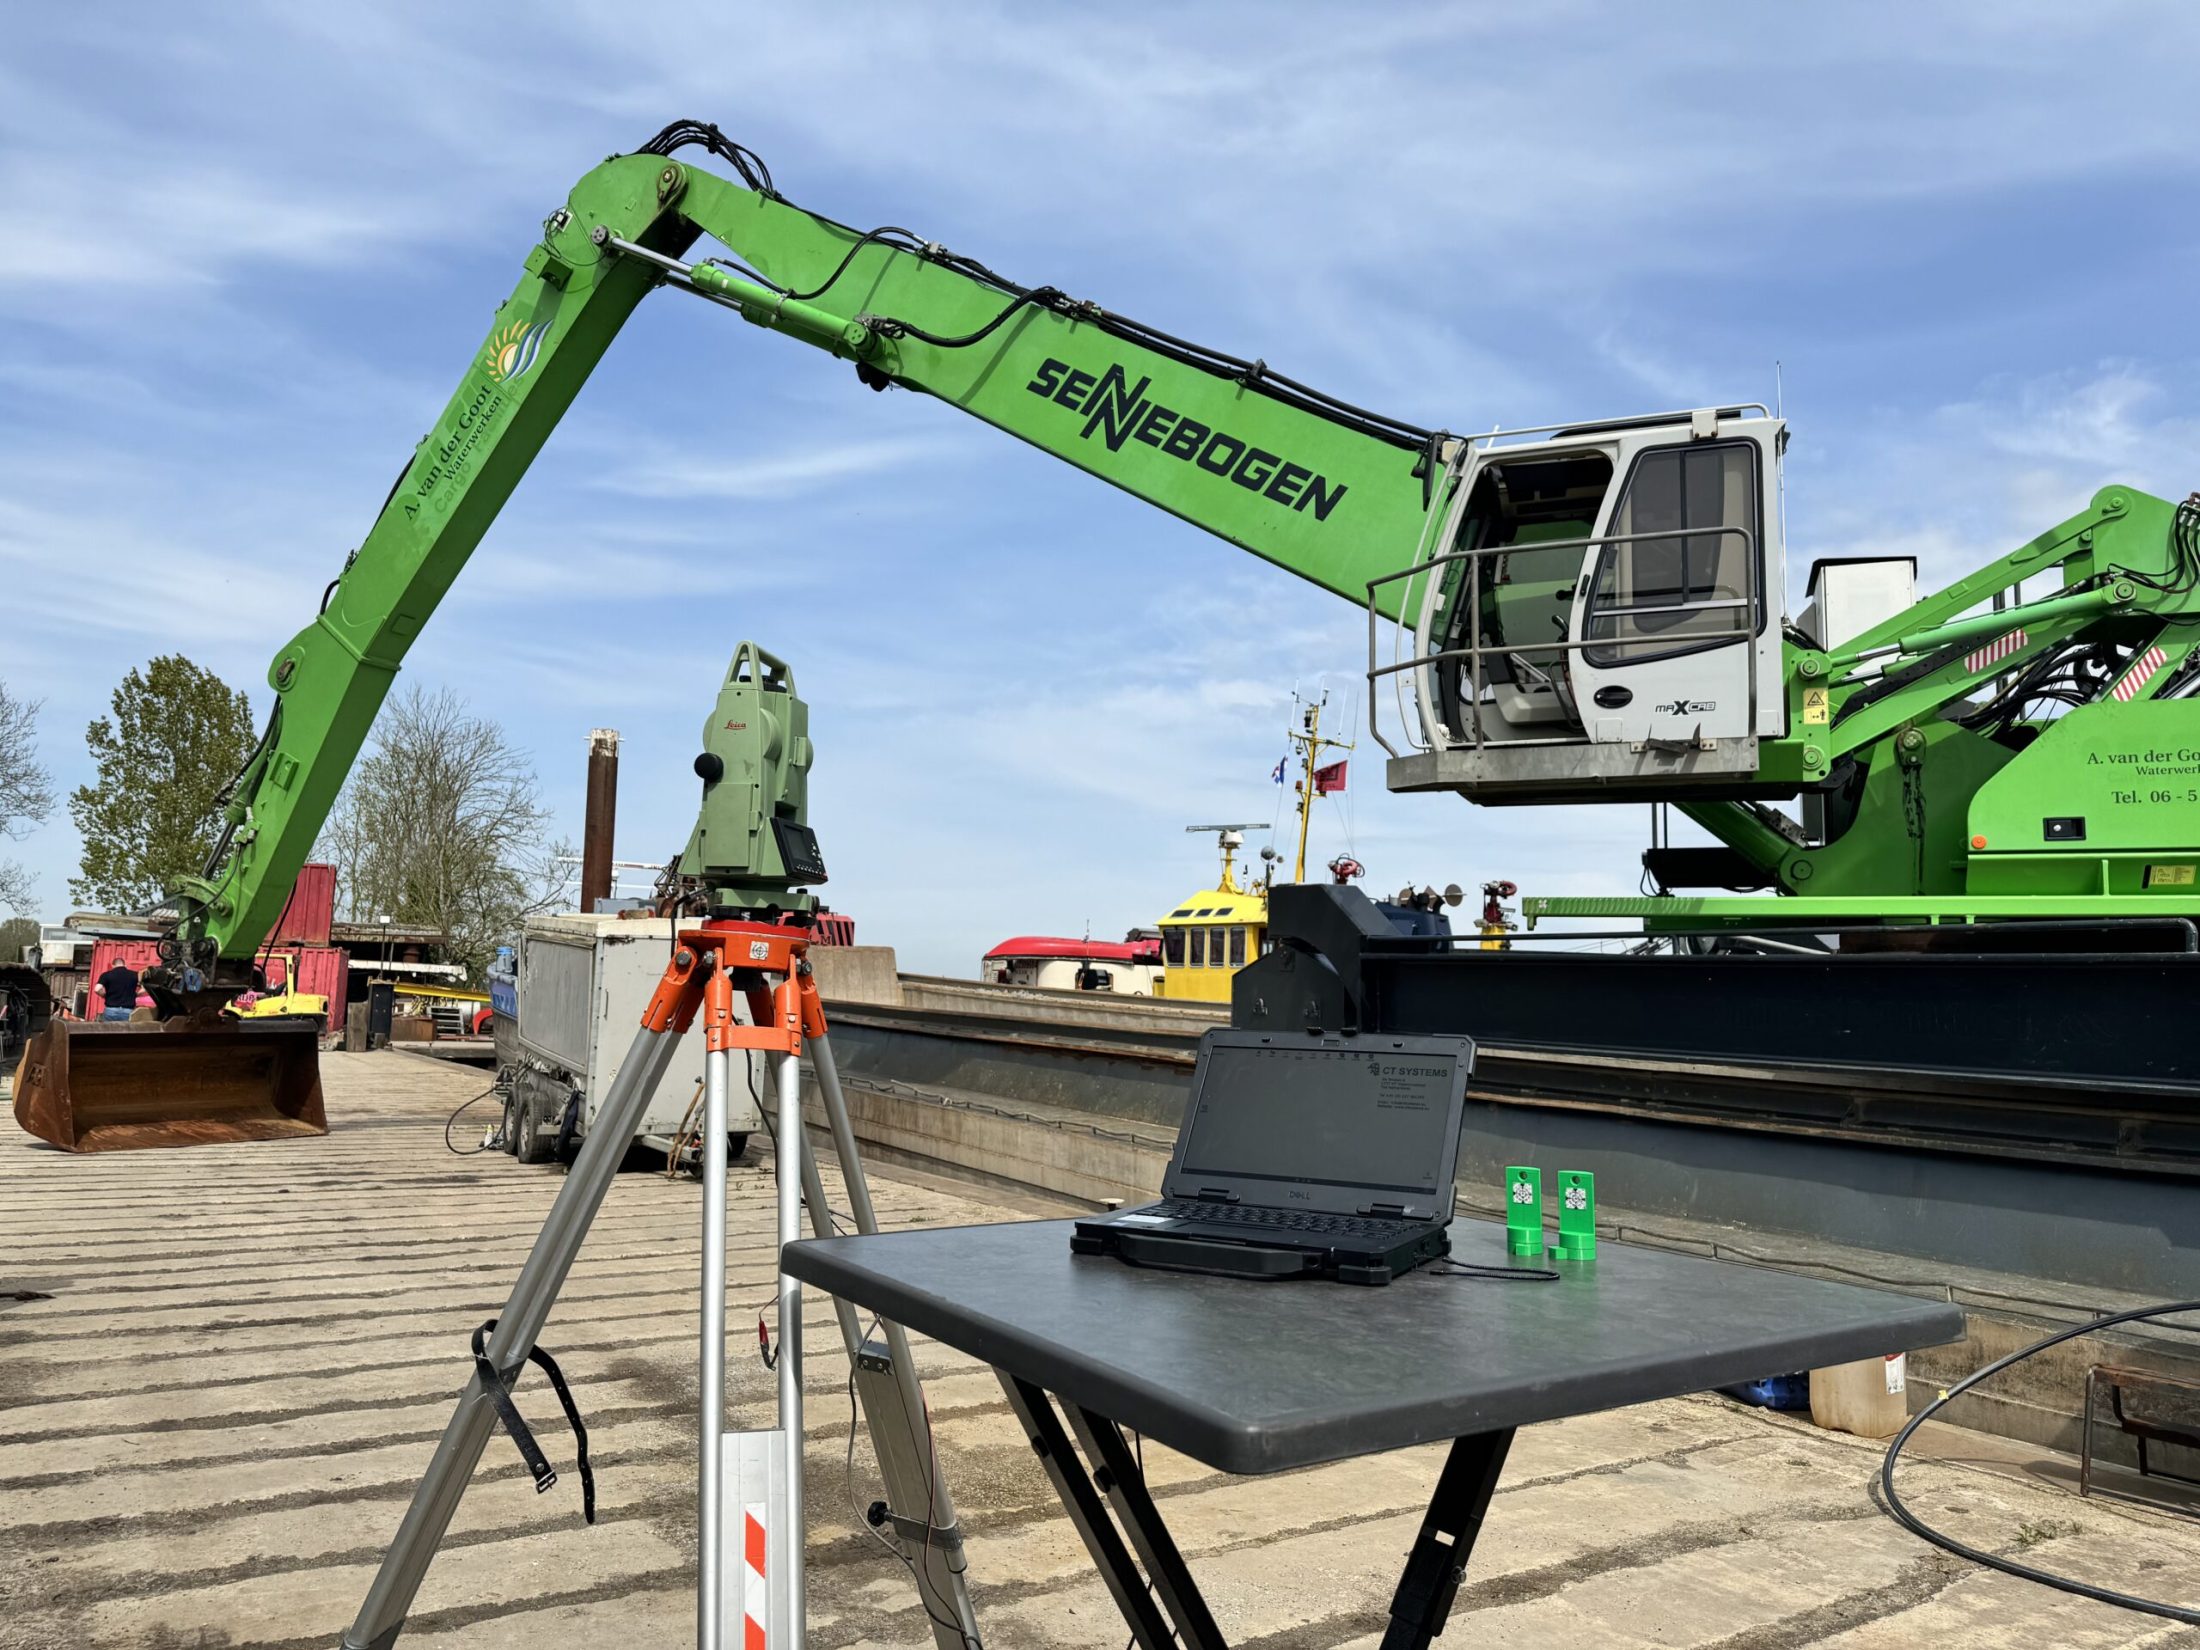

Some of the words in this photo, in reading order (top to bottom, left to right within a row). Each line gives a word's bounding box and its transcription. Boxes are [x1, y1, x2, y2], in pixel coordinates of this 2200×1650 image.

[404, 502, 420, 520] A.
[417, 465, 442, 497] van
[439, 431, 462, 463] der
[459, 384, 492, 429] Goot
[444, 395, 502, 481] Waterwerken
[1026, 357, 1349, 522] SENNEBOGEN
[2087, 752, 2104, 765] A.
[2108, 754, 2139, 764] van
[2144, 749, 2173, 763] der
[2111, 790, 2142, 804] Tel.
[2150, 790, 2171, 803] 06
[2187, 789, 2198, 802] 5
[1382, 1066, 1397, 1075] CT
[1398, 1067, 1448, 1077] SYSTEMS
